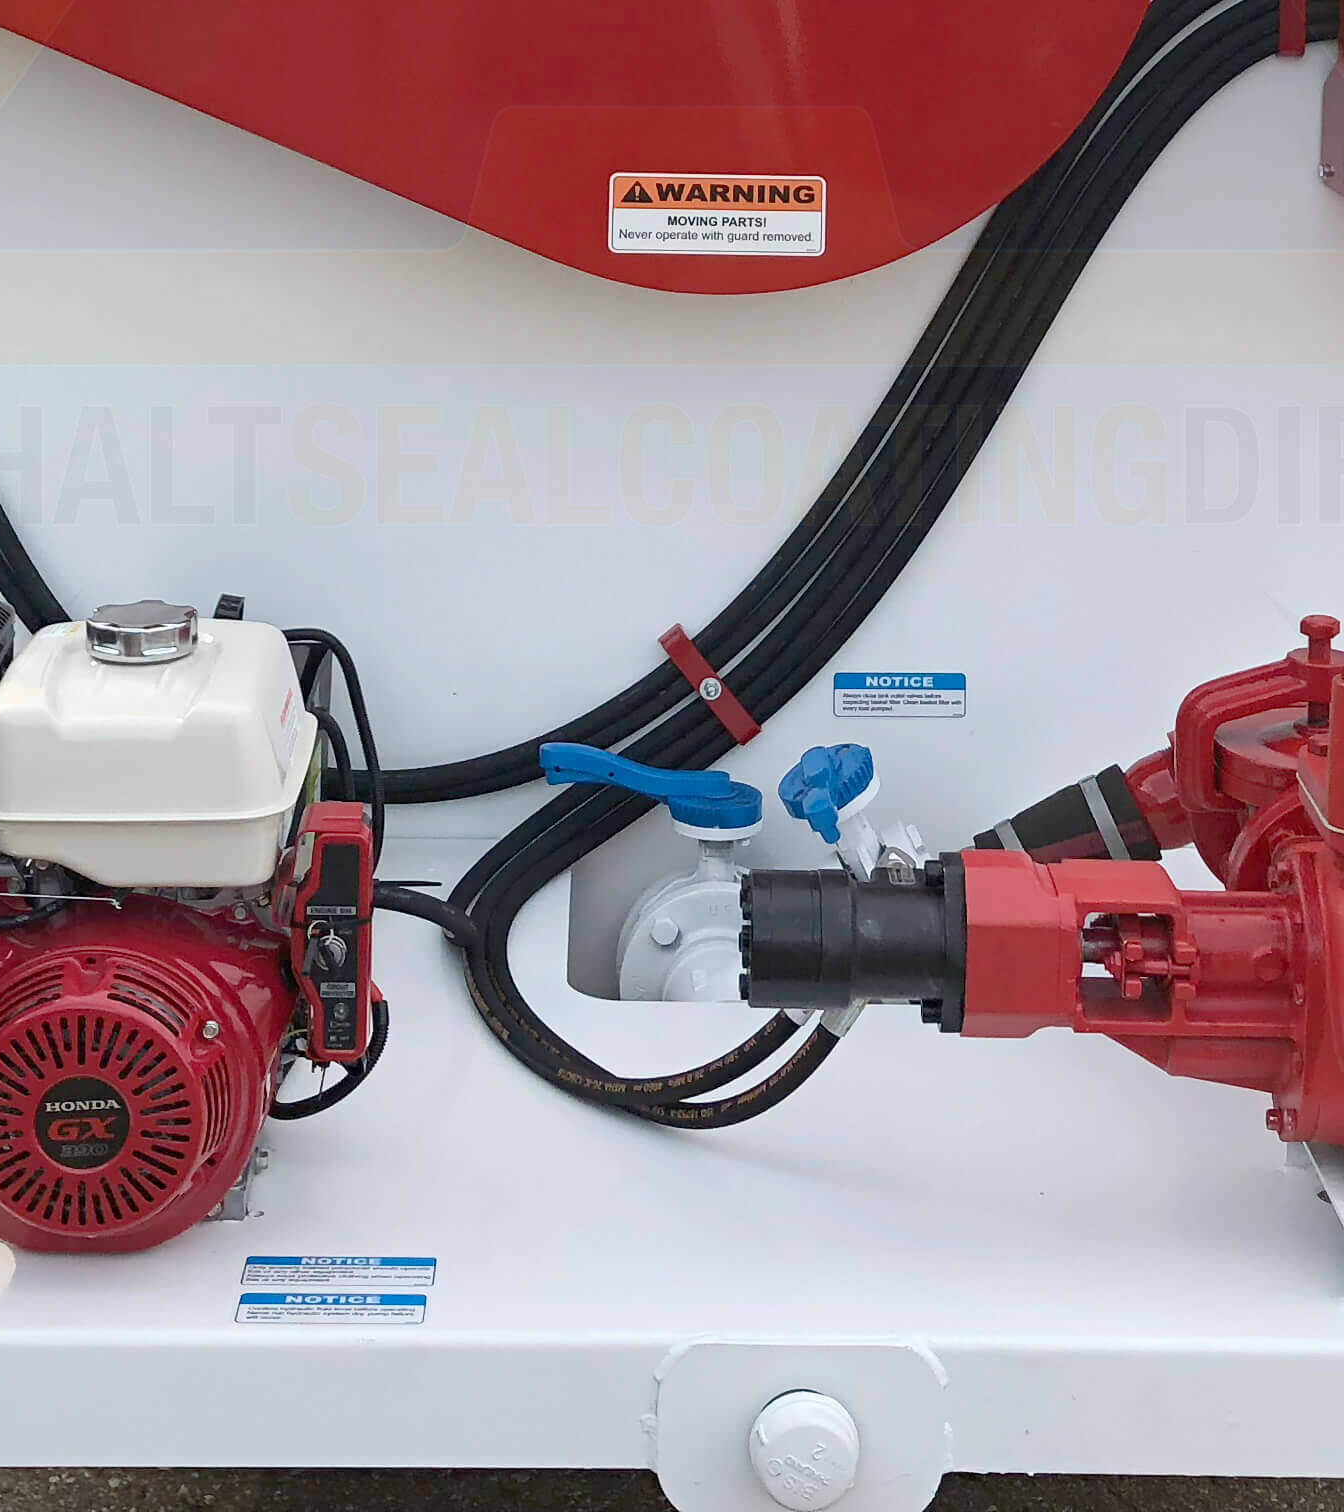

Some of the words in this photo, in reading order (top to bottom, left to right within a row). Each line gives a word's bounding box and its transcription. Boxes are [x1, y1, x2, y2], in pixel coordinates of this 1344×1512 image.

[655, 182, 816, 204] WARNING
[667, 216, 718, 227] MOVING
[721, 216, 767, 228] PARTS!
[619, 229, 652, 240] Never
[655, 230, 698, 243] operate
[701, 230, 724, 240] with
[727, 230, 760, 243] guard
[762, 231, 814, 242] removed.
[865, 676, 934, 687] NOTICE
[45, 1099, 121, 1113] HONDA
[48, 1116, 118, 1141] GX
[301, 1257, 382, 1265] NOTICE
[285, 1295, 381, 1304] NOTICE
